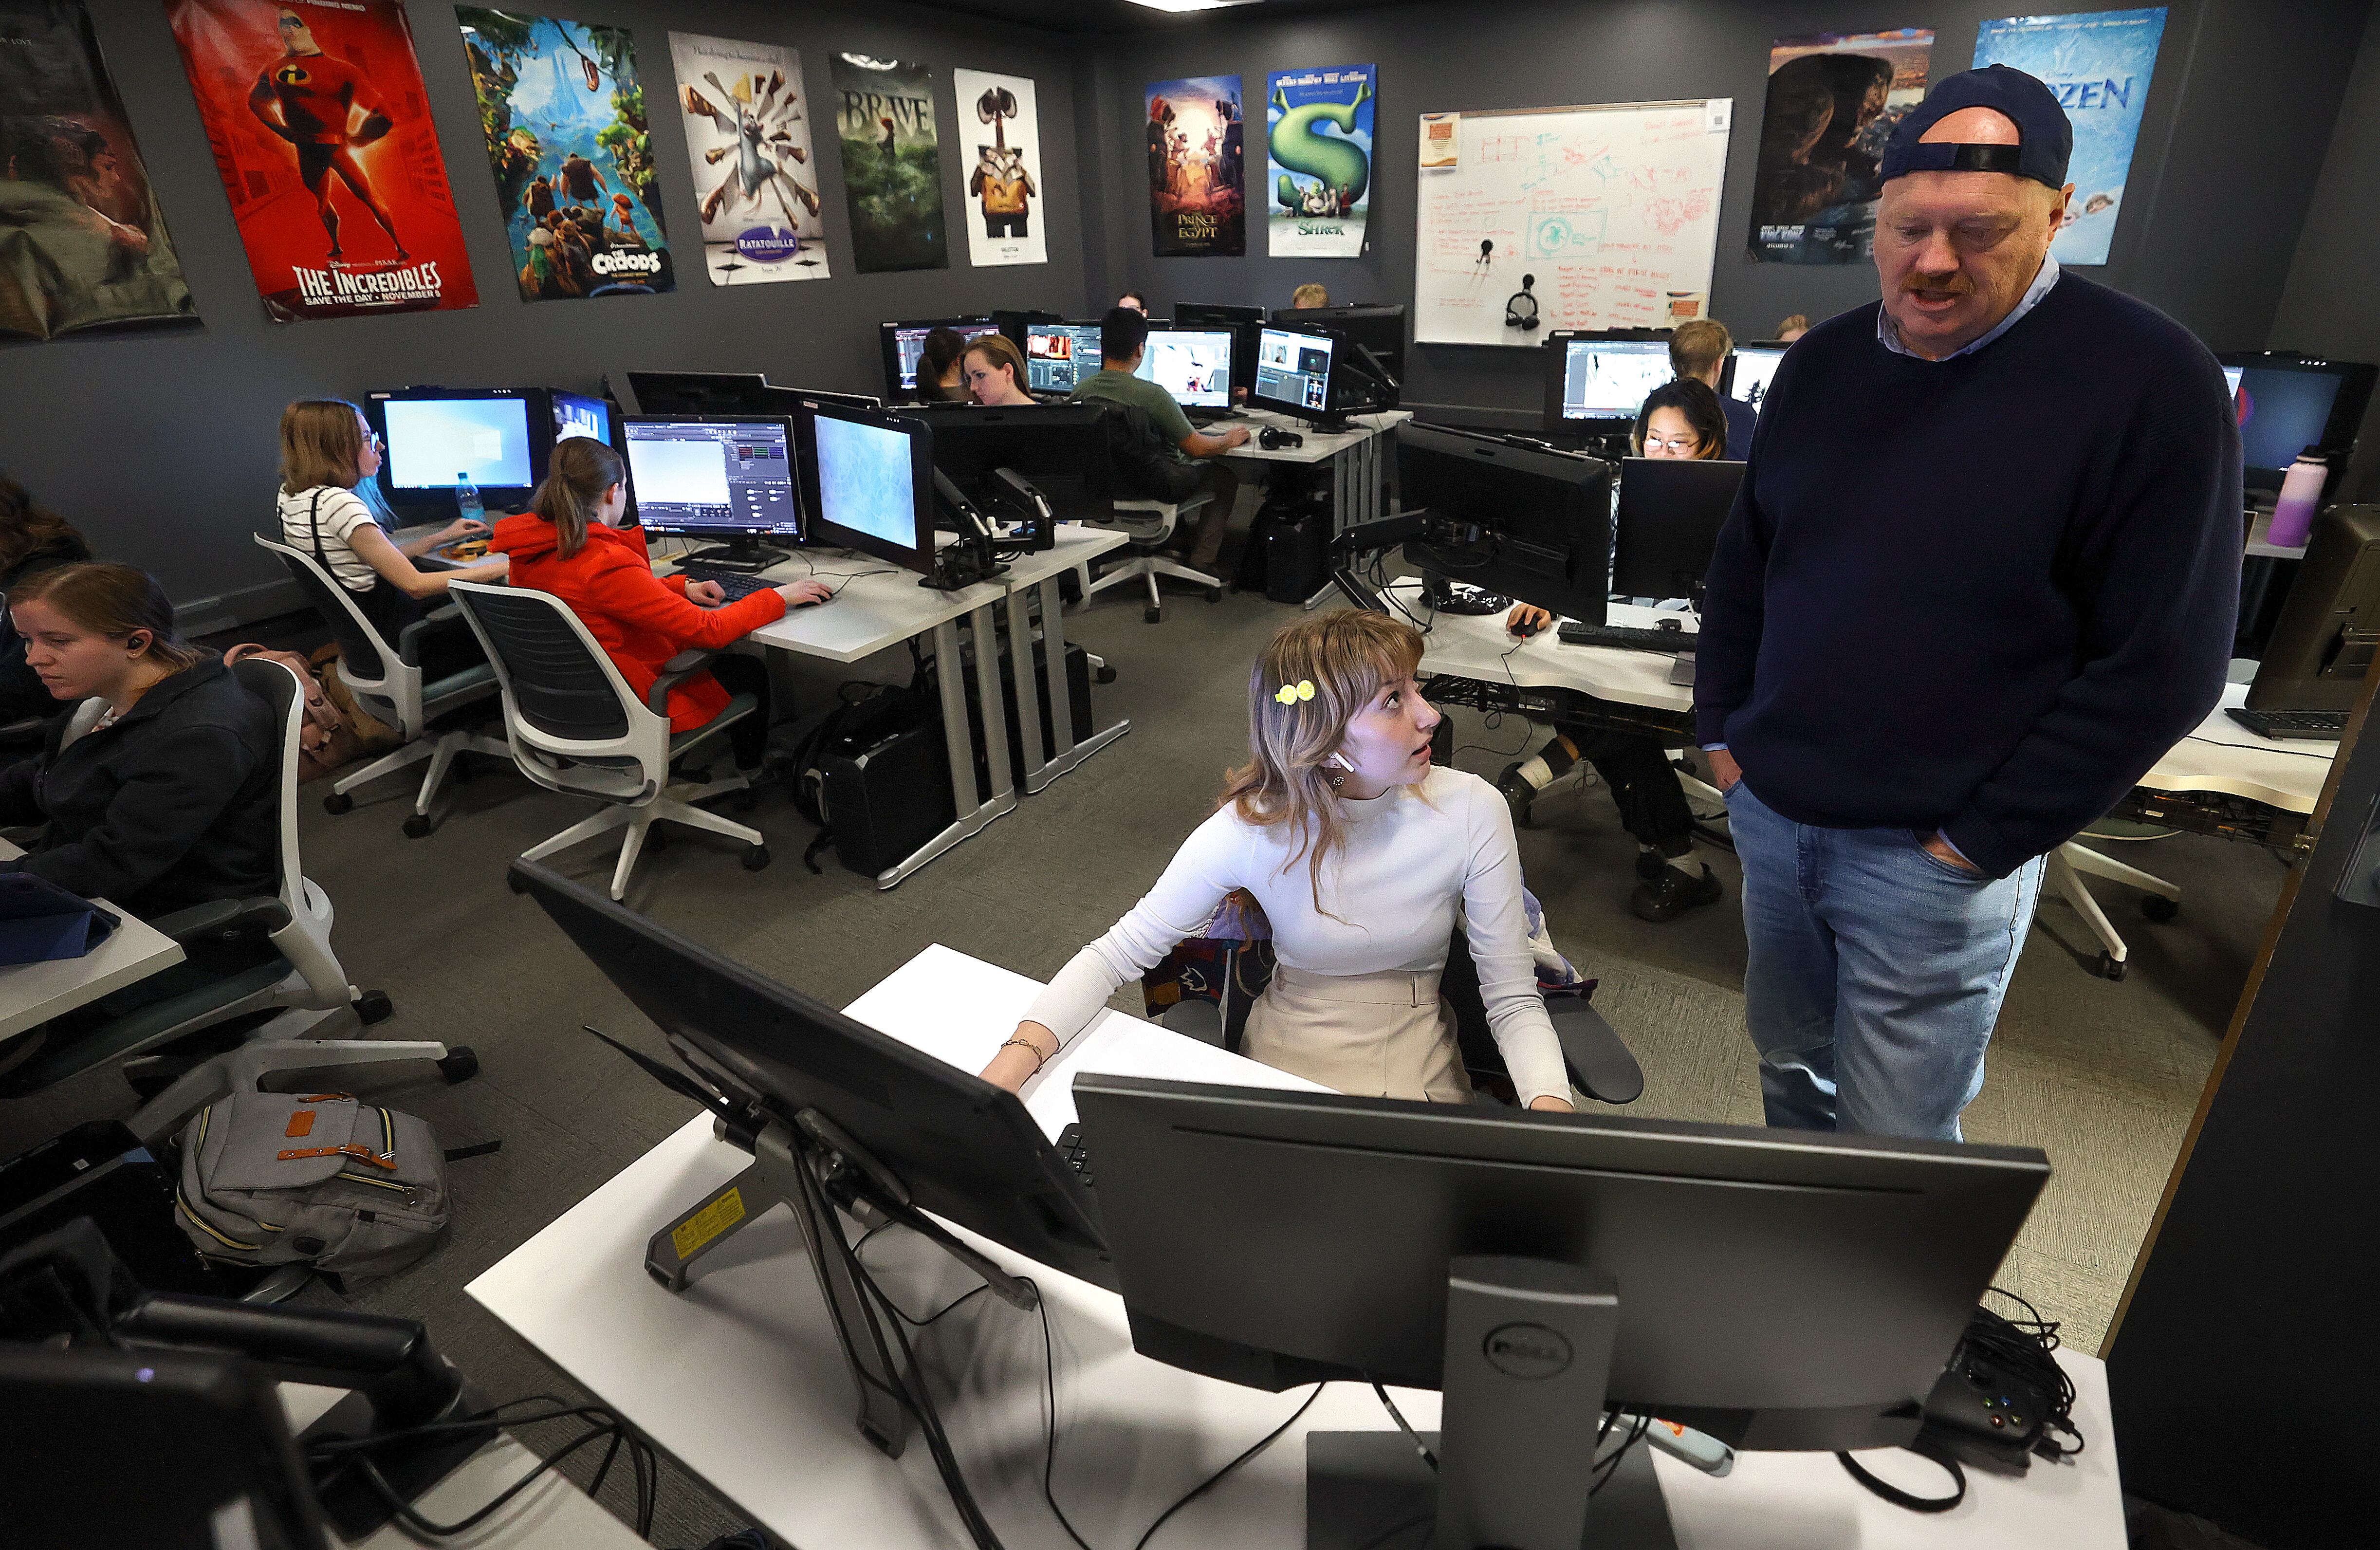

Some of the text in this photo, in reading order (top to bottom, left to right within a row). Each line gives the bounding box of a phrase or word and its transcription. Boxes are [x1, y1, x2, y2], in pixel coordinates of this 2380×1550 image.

[2046, 77, 2133, 109] ZEN
[839, 90, 927, 130] BRAVE
[1178, 214, 1218, 226] PRINCE
[1179, 226, 1219, 239] EGYPT
[1298, 221, 1345, 237] SHREK
[738, 239, 794, 249] RATATOUILLE
[591, 252, 662, 275] CROODS
[292, 260, 442, 297] THE INCREDIBLES
[304, 295, 332, 305] SAVE
[333, 294, 354, 304] THE
[355, 293, 374, 302] DAY
[381, 290, 433, 301] NOVEMBER
